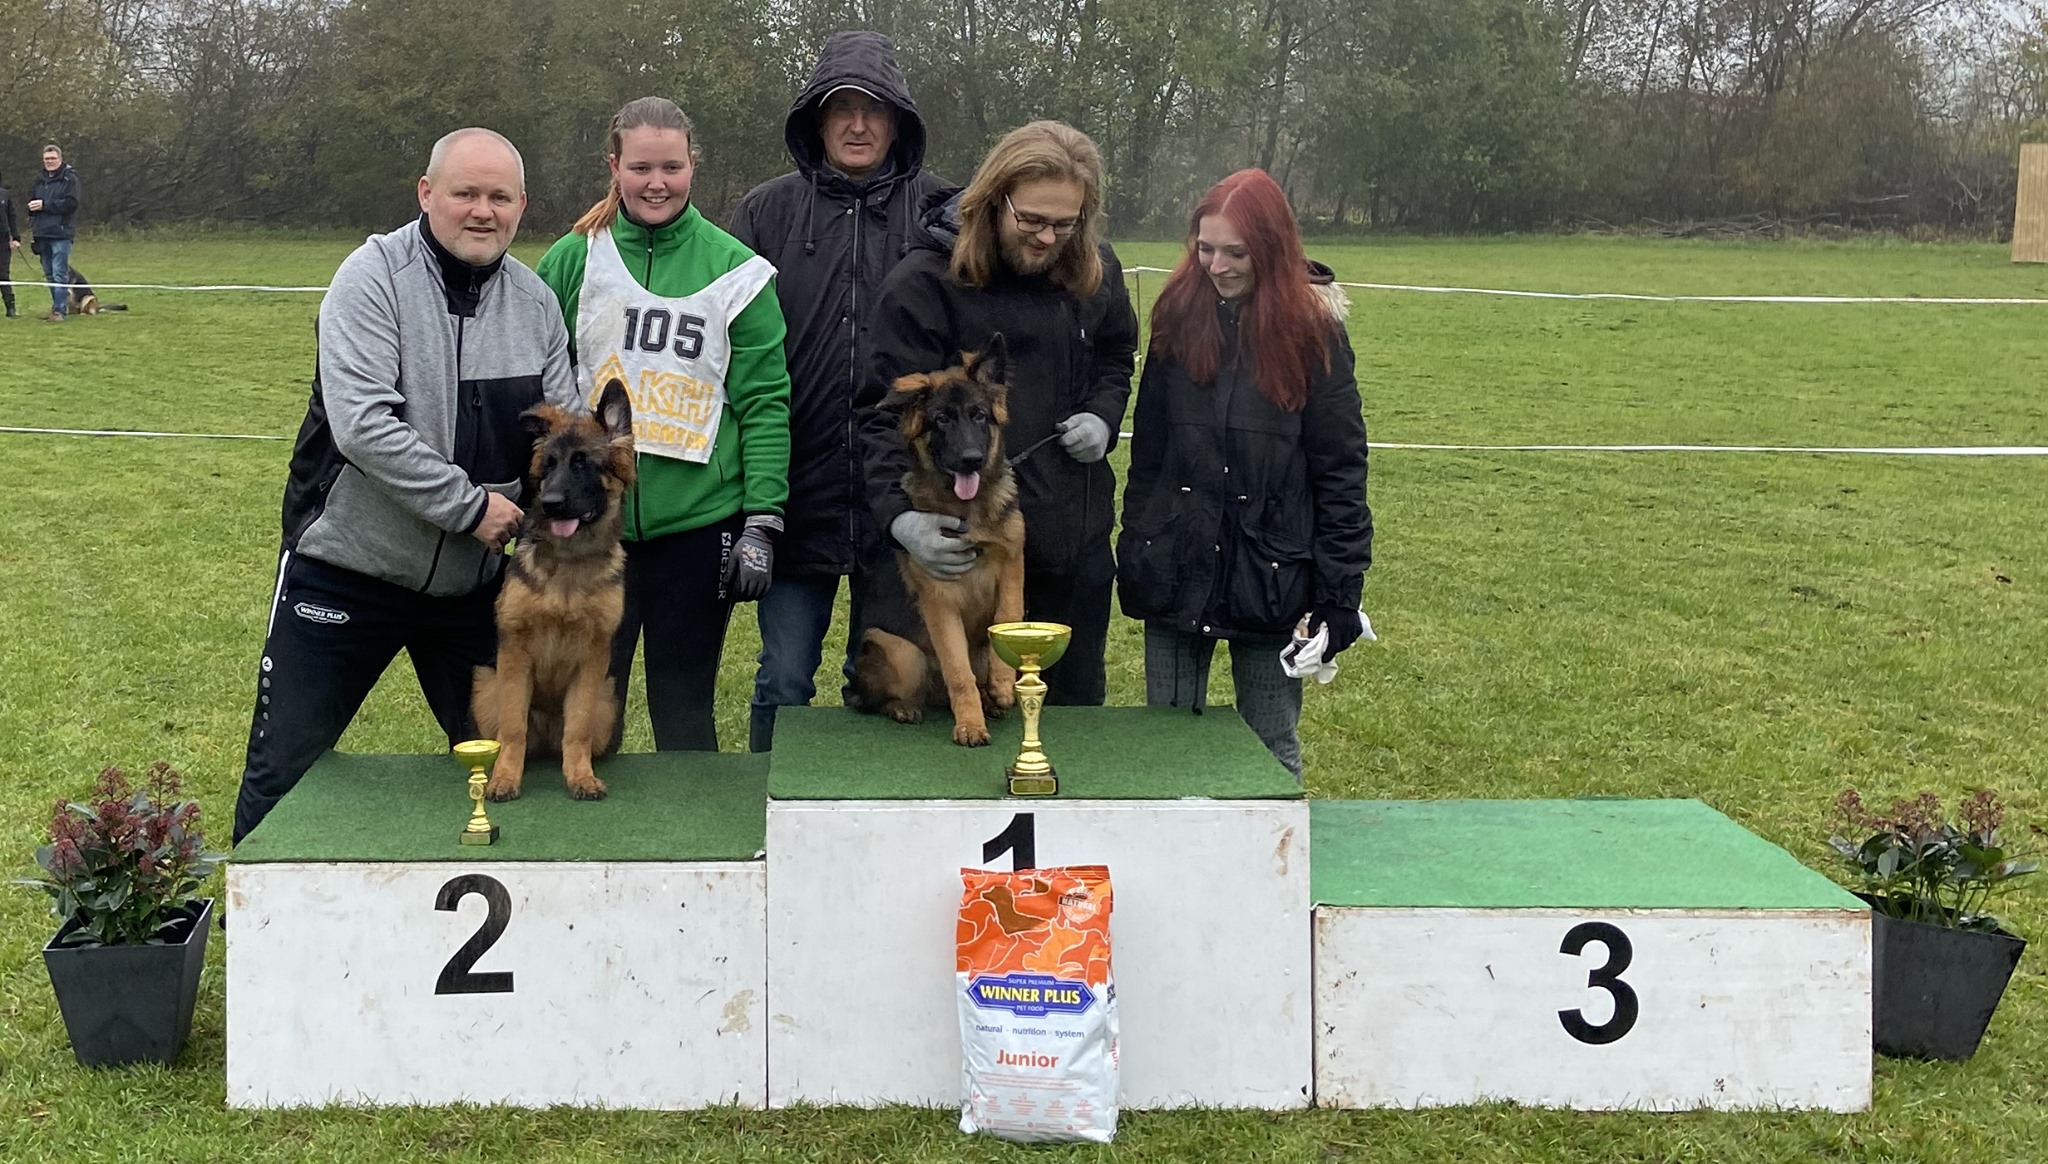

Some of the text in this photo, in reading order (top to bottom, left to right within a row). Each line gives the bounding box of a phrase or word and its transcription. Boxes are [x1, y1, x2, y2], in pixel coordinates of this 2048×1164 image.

[622, 306, 707, 361] 105
[983, 813, 1036, 872] 1
[433, 873, 514, 995] 2
[980, 985, 1081, 1004] WINNER PLUS
[1558, 921, 1639, 1045] 3
[976, 1024, 1085, 1039] natural nutrition system
[996, 1049, 1060, 1068] Junior
